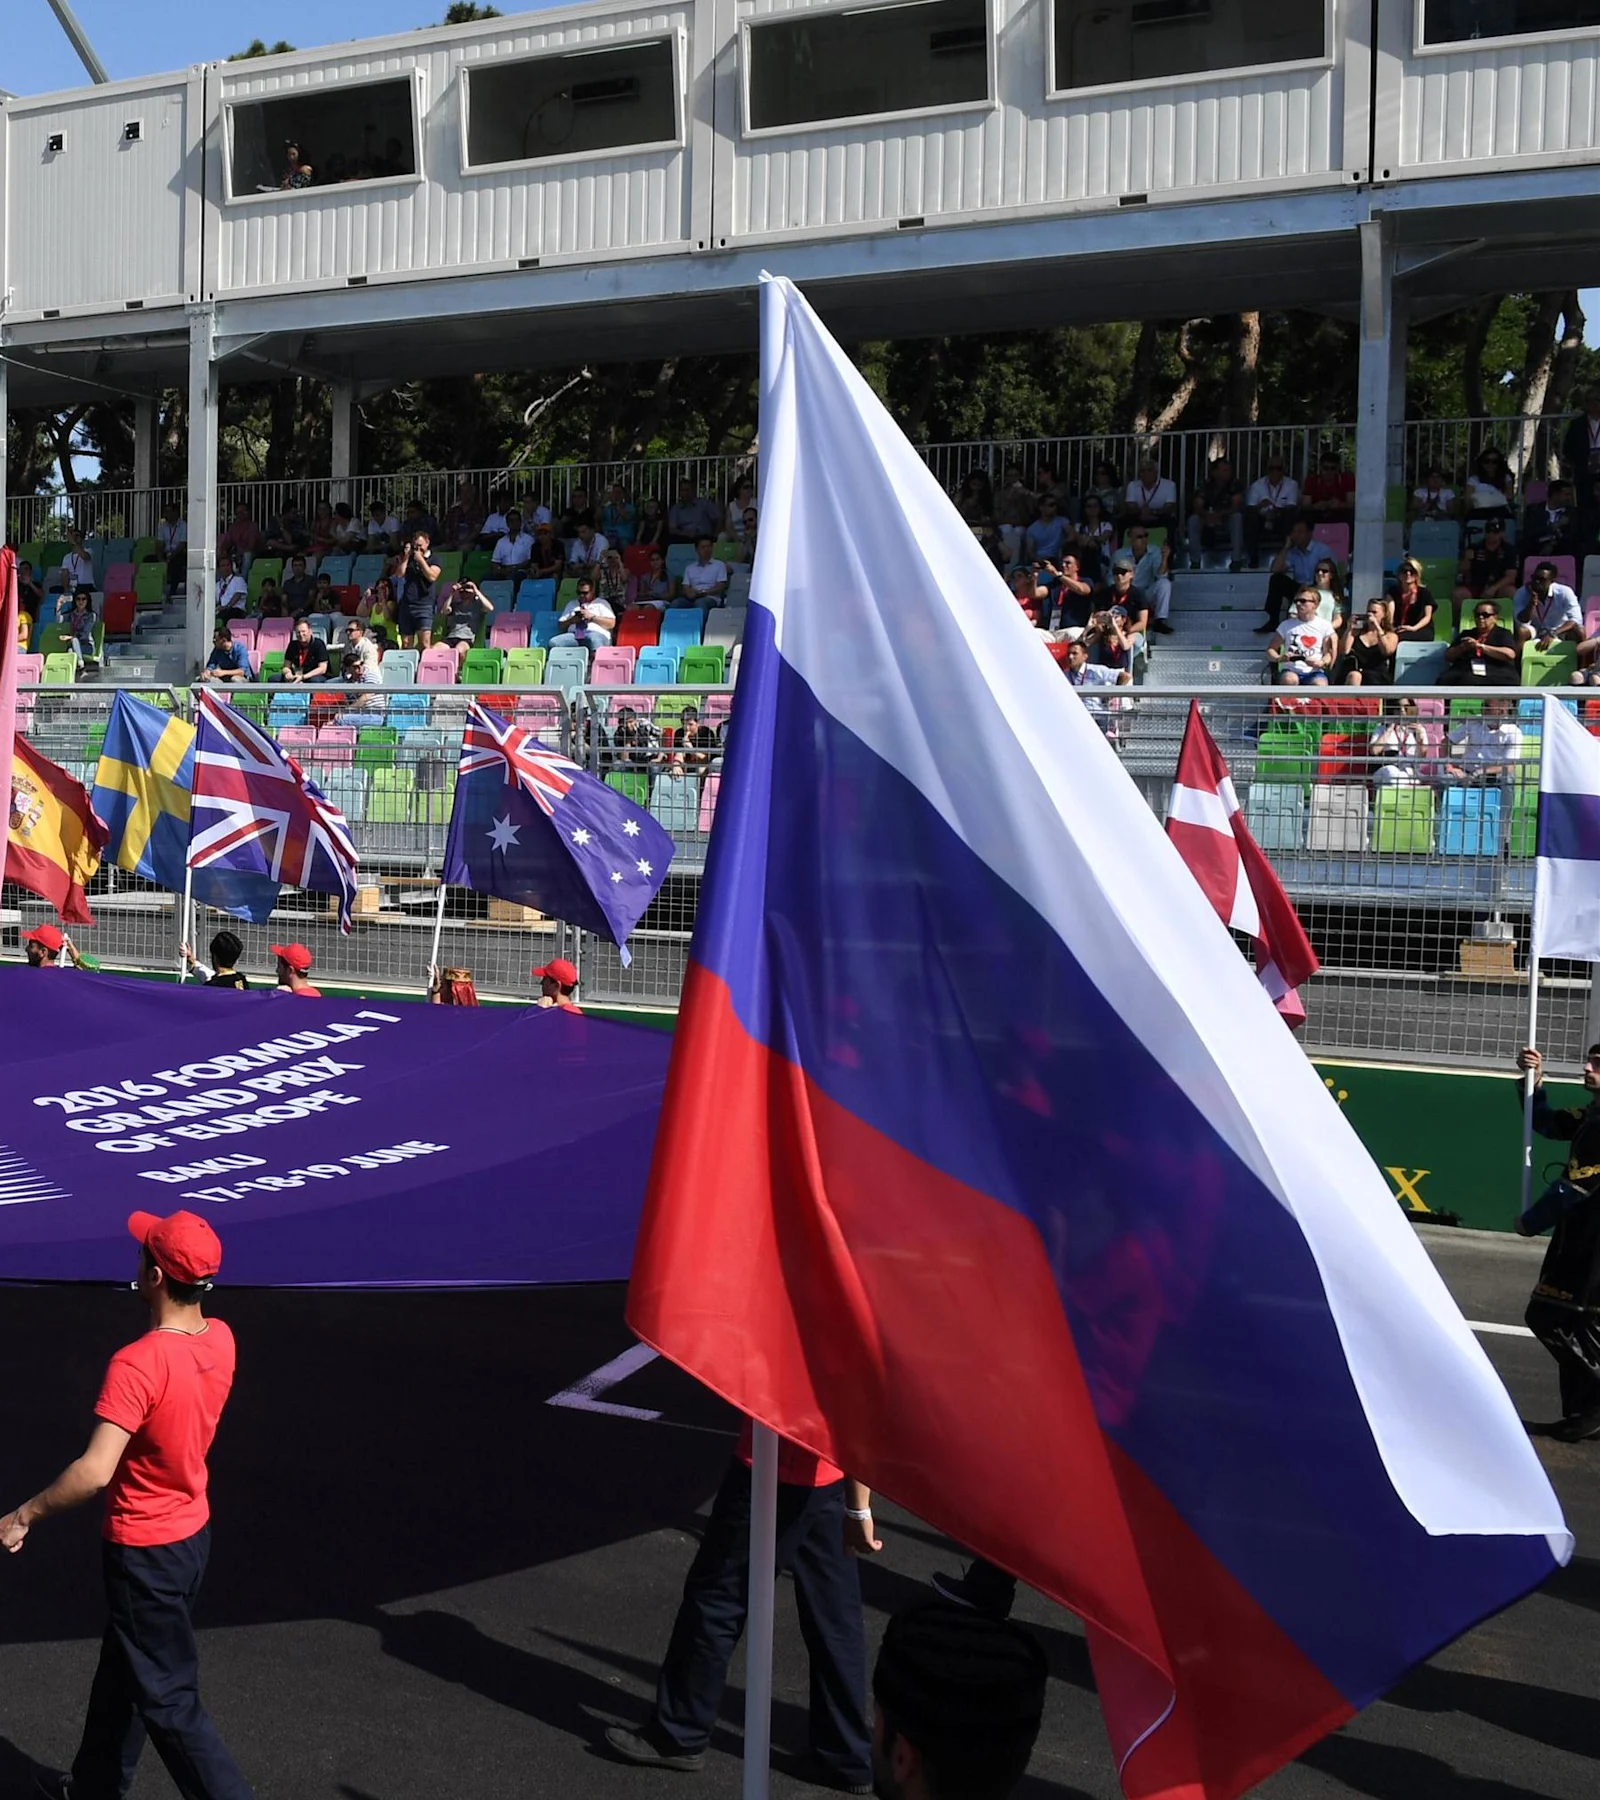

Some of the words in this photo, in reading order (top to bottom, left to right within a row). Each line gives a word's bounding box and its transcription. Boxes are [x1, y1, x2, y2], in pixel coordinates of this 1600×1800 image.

[33, 1079, 167, 1114] 2016
[152, 1022, 380, 1088] FORMULA
[355, 1010, 401, 1023] 1
[65, 1088, 258, 1134] GRAND
[240, 1055, 366, 1095] PRIX
[95, 1132, 177, 1154] OF
[165, 1089, 362, 1141] EUROPE
[137, 1153, 268, 1184] BAKU
[180, 1163, 352, 1203] 17-18-19
[343, 1139, 451, 1170] JUNE
